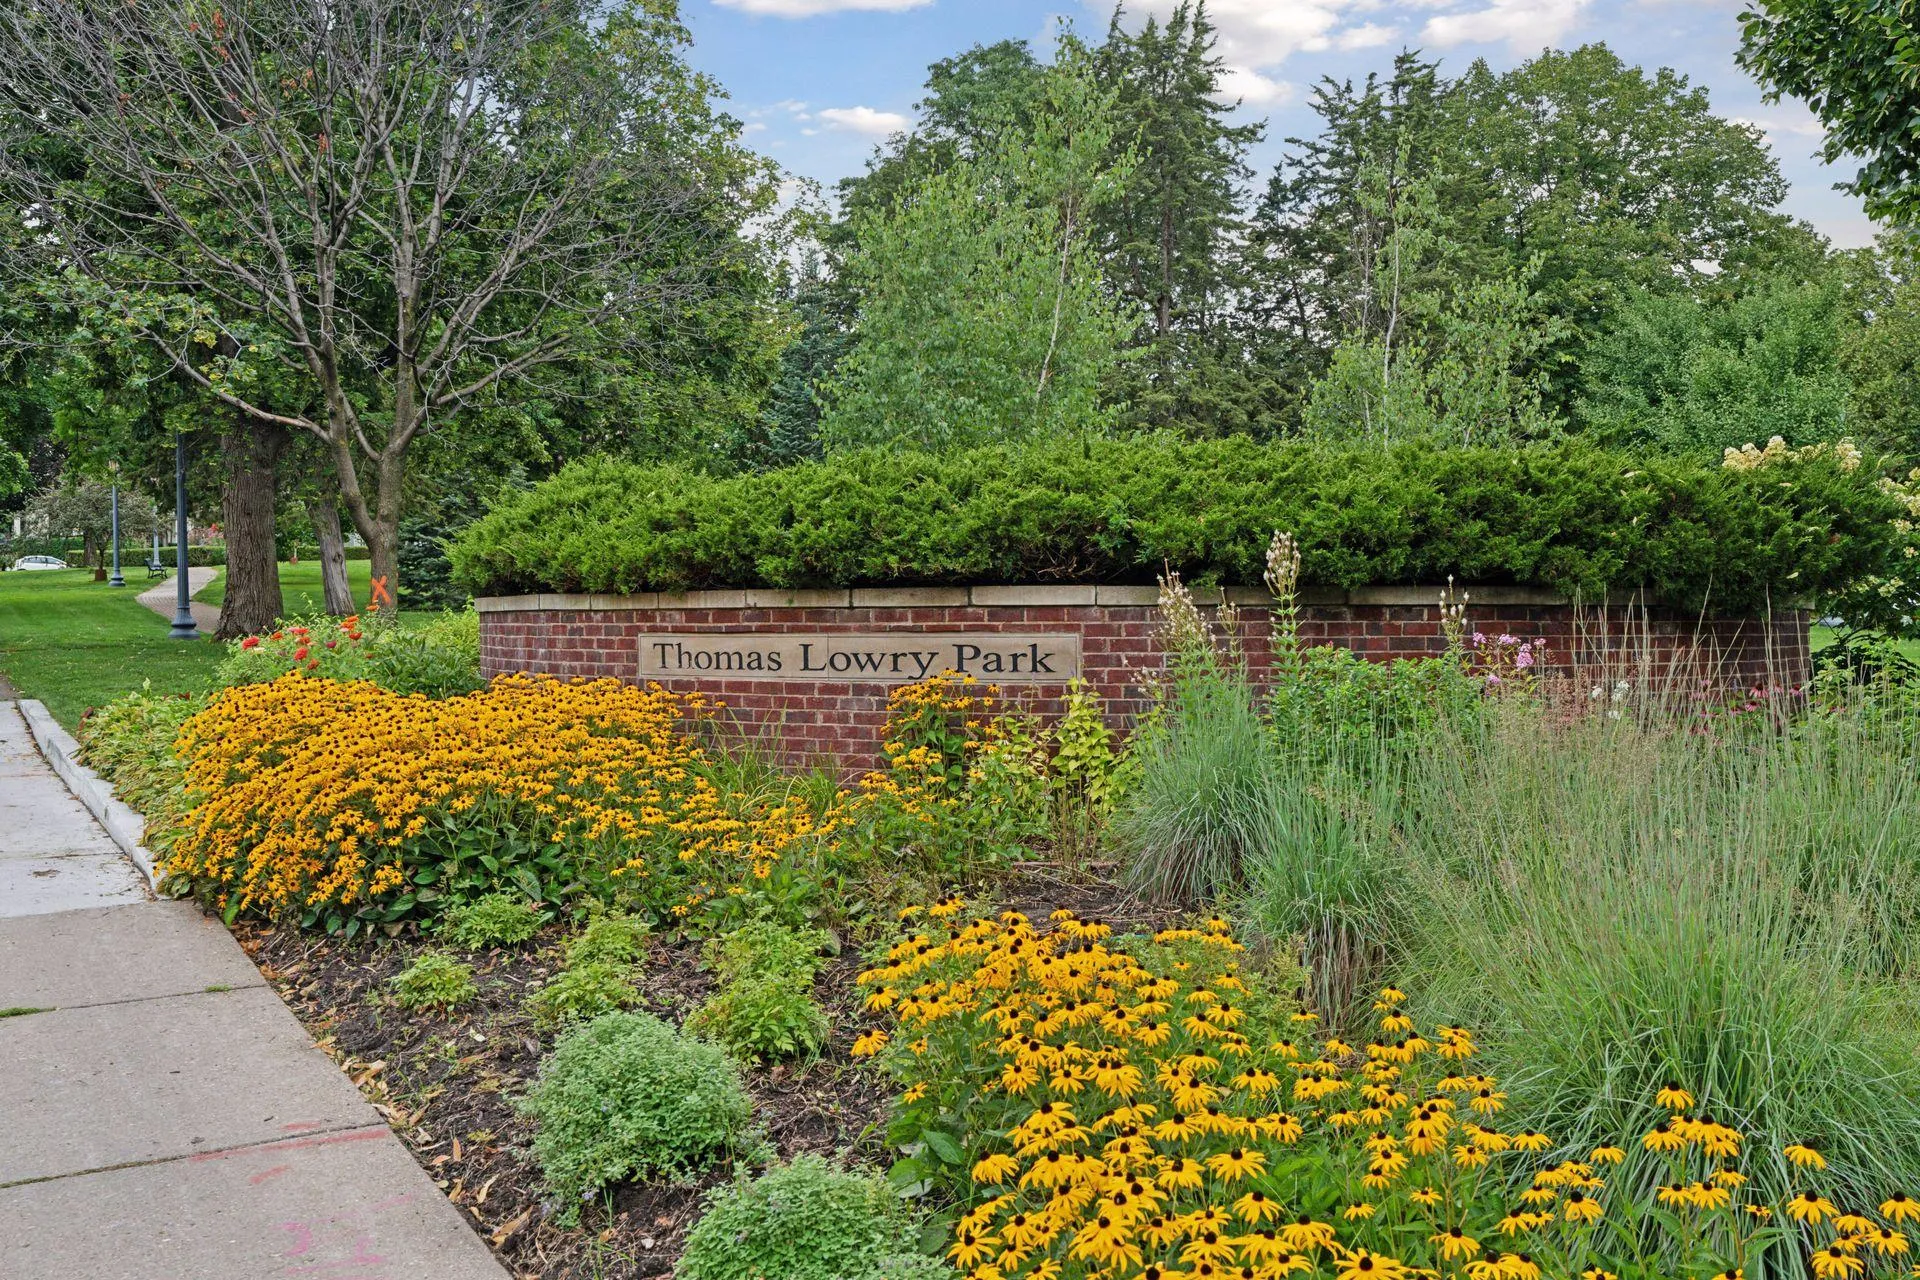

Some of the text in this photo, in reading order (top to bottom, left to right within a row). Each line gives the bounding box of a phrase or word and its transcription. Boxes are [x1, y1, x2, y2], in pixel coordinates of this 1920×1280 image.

[652, 642, 1056, 680] Thomas Lowry Park
